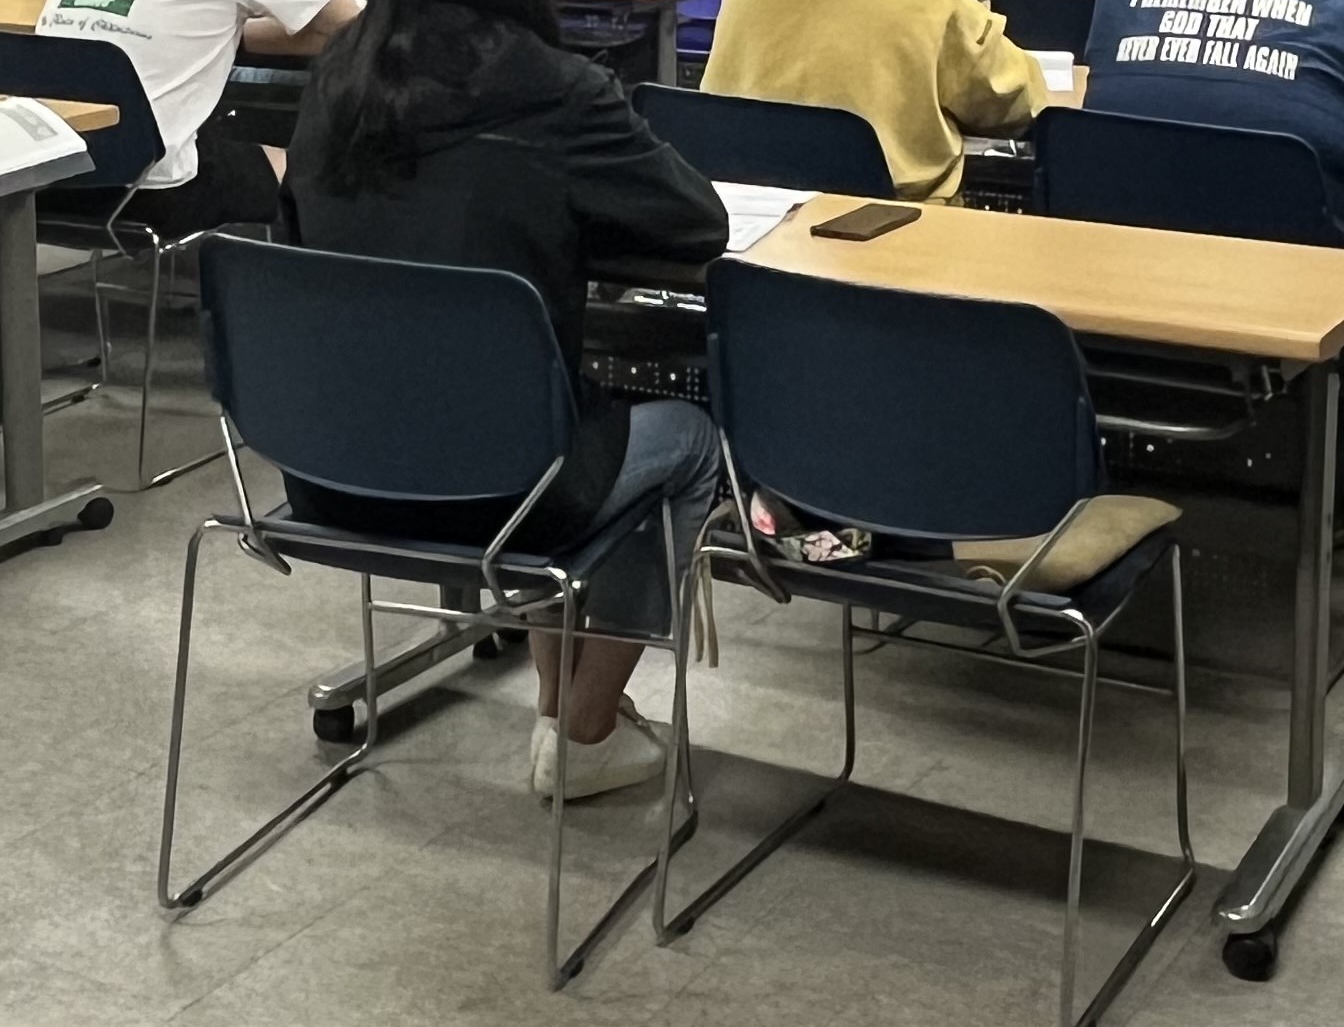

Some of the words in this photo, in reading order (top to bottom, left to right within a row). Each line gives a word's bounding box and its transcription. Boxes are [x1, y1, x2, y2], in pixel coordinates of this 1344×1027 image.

[1158, 10, 1204, 36] GOD
[1206, 14, 1260, 41] THAT
[1161, 37, 1201, 63] EVER
[1202, 39, 1240, 68] FALL
[1243, 45, 1298, 80] AGAIN
